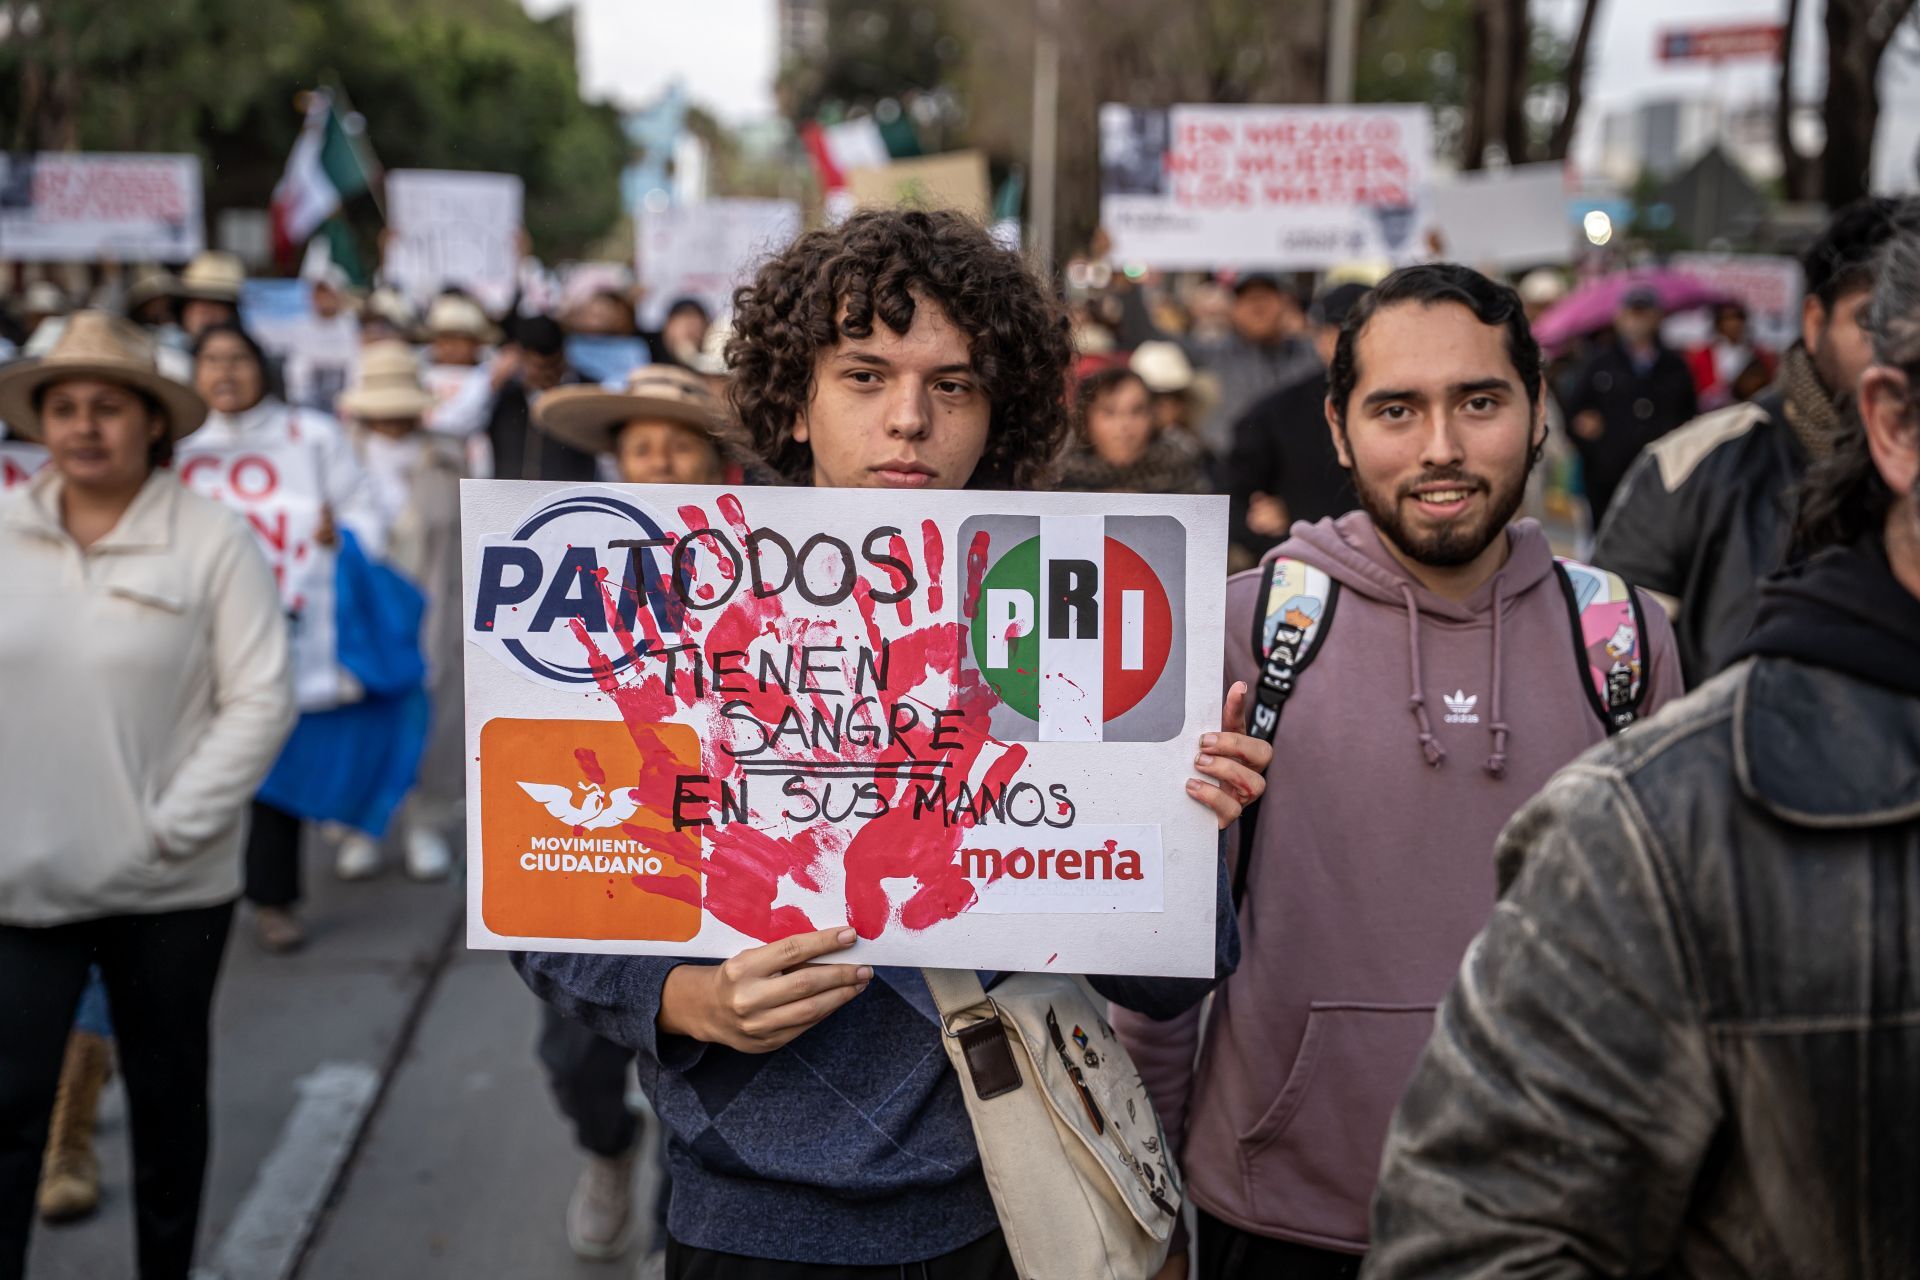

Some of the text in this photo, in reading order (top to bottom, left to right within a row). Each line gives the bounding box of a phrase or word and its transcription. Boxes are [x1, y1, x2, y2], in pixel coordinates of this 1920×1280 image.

[474, 546, 696, 632] PAN
[608, 526, 918, 610] TODOS
[986, 559, 1144, 670] PRI
[643, 638, 890, 699] TIENEN
[720, 697, 966, 759] SANGRE
[672, 775, 1076, 832] EN SUS MANOS
[520, 853, 662, 875] CIUDADANO
[960, 847, 1144, 881] morena
